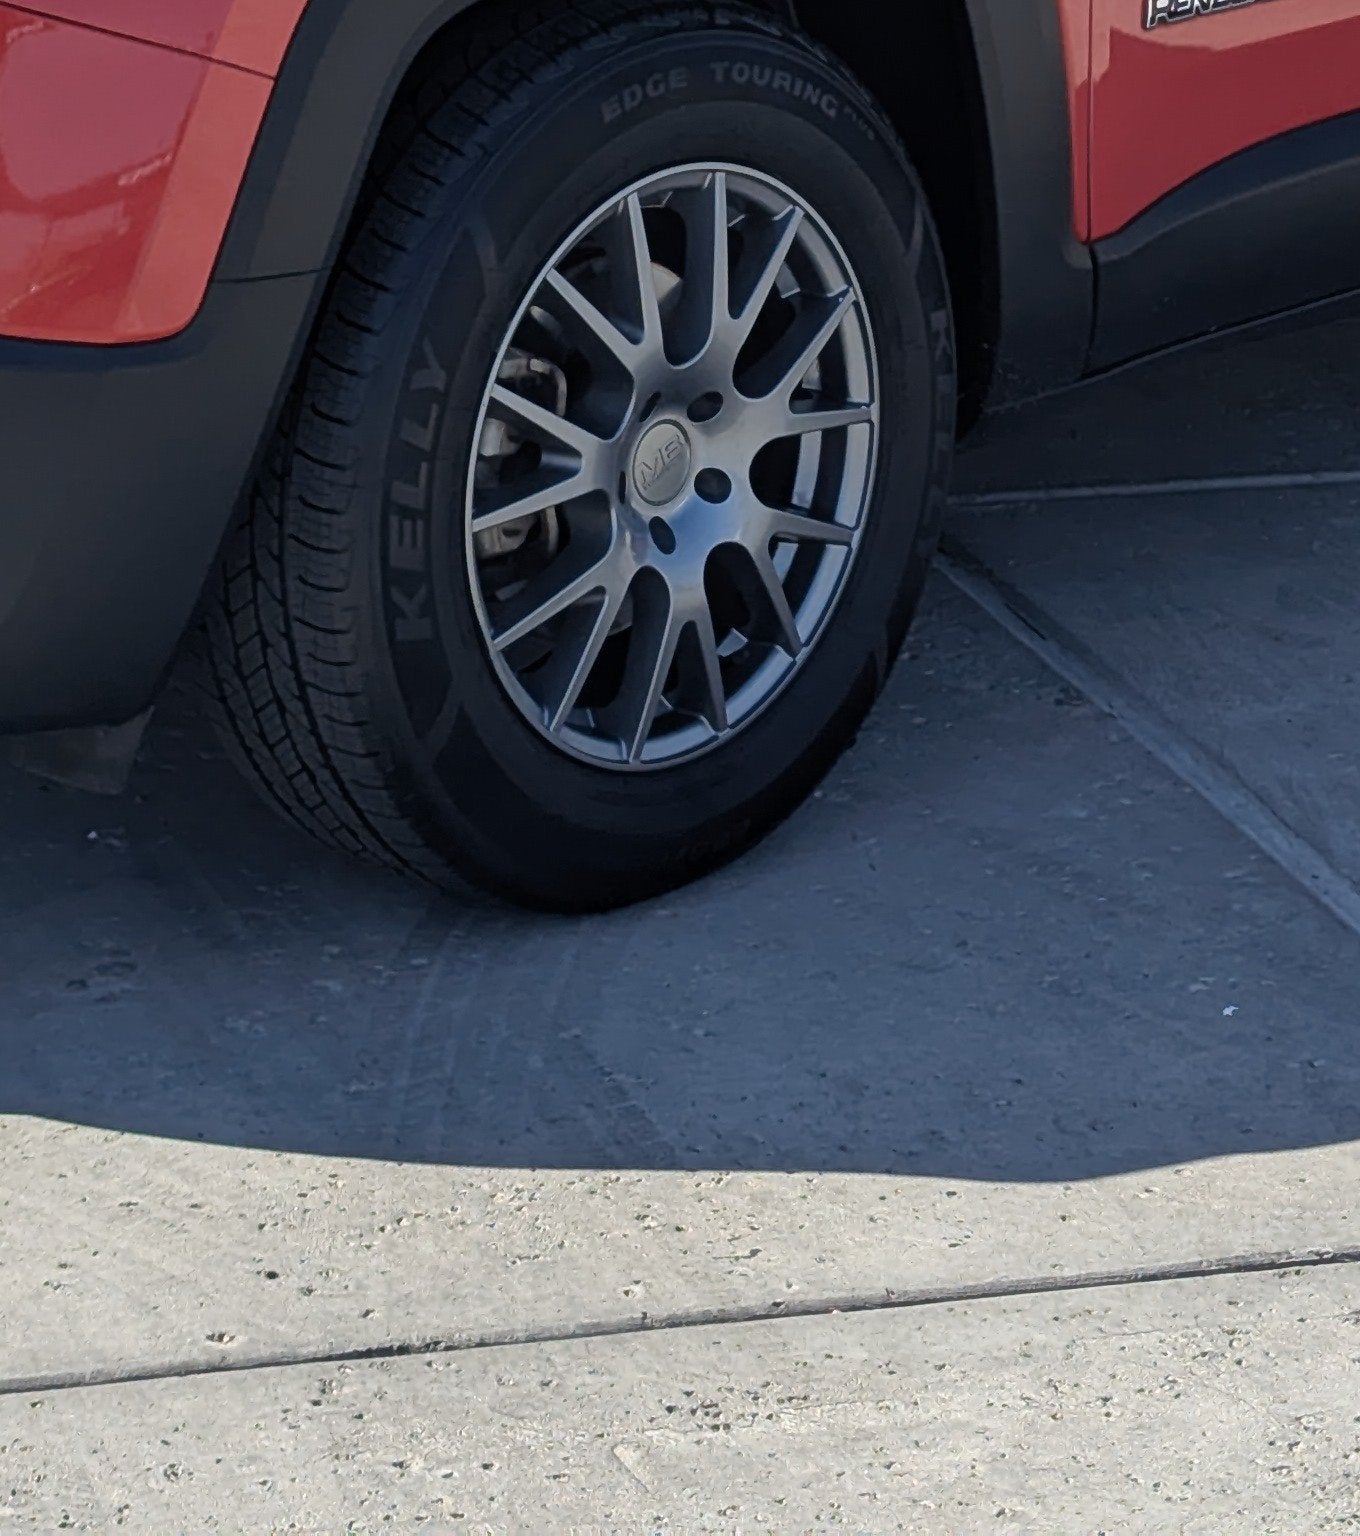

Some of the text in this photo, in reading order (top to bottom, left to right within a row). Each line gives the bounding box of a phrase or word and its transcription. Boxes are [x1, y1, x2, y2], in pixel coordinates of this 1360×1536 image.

[600, 66, 688, 124] EDGE
[709, 60, 838, 119] TOURING
[390, 335, 448, 632] KELLY
